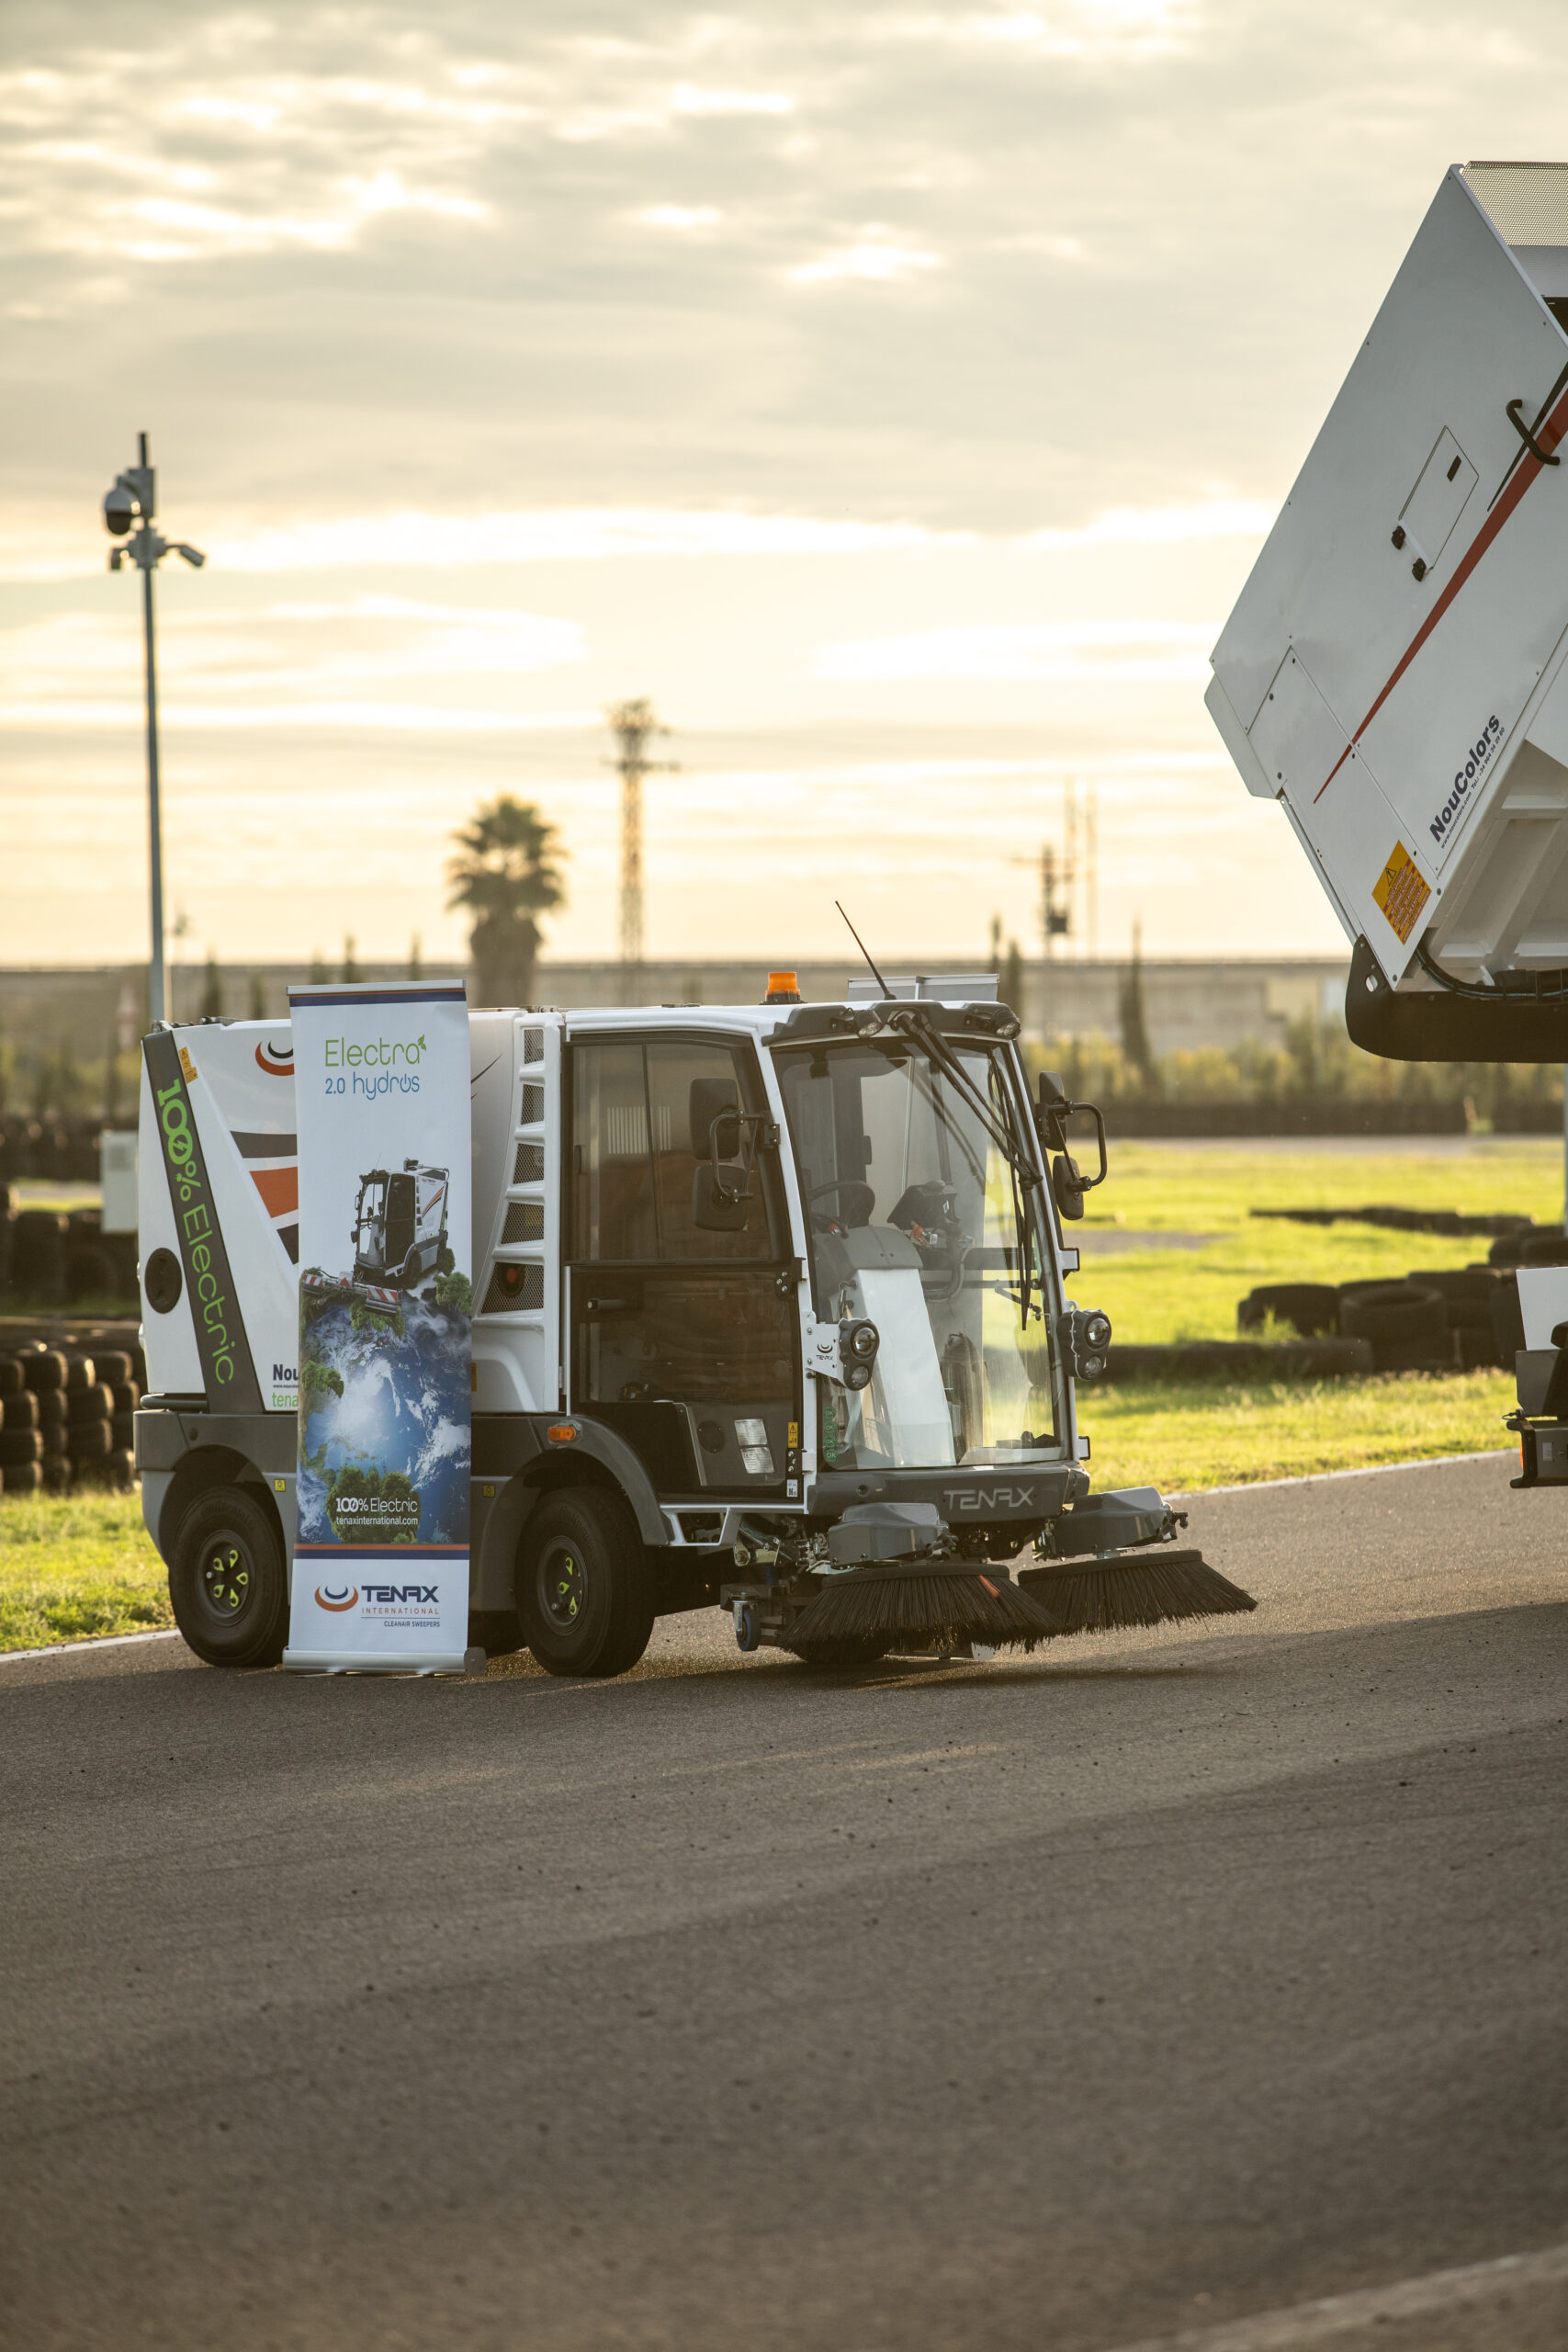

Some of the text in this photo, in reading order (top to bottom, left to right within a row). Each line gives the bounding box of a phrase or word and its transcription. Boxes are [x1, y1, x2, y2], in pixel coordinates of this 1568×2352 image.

[1429, 715, 1500, 842] NouColors
[325, 1036, 421, 1067] Electra
[325, 1078, 345, 1094] 2.0
[156, 1078, 235, 1385] 100% Electric
[335, 1497, 418, 1512] 100% Electric
[943, 1487, 1035, 1510] TENAX
[336, 1515, 418, 1525] tenaxinternational.com
[361, 1585, 439, 1603] TENAX
[361, 1607, 439, 1615] INTERNATIONAL
